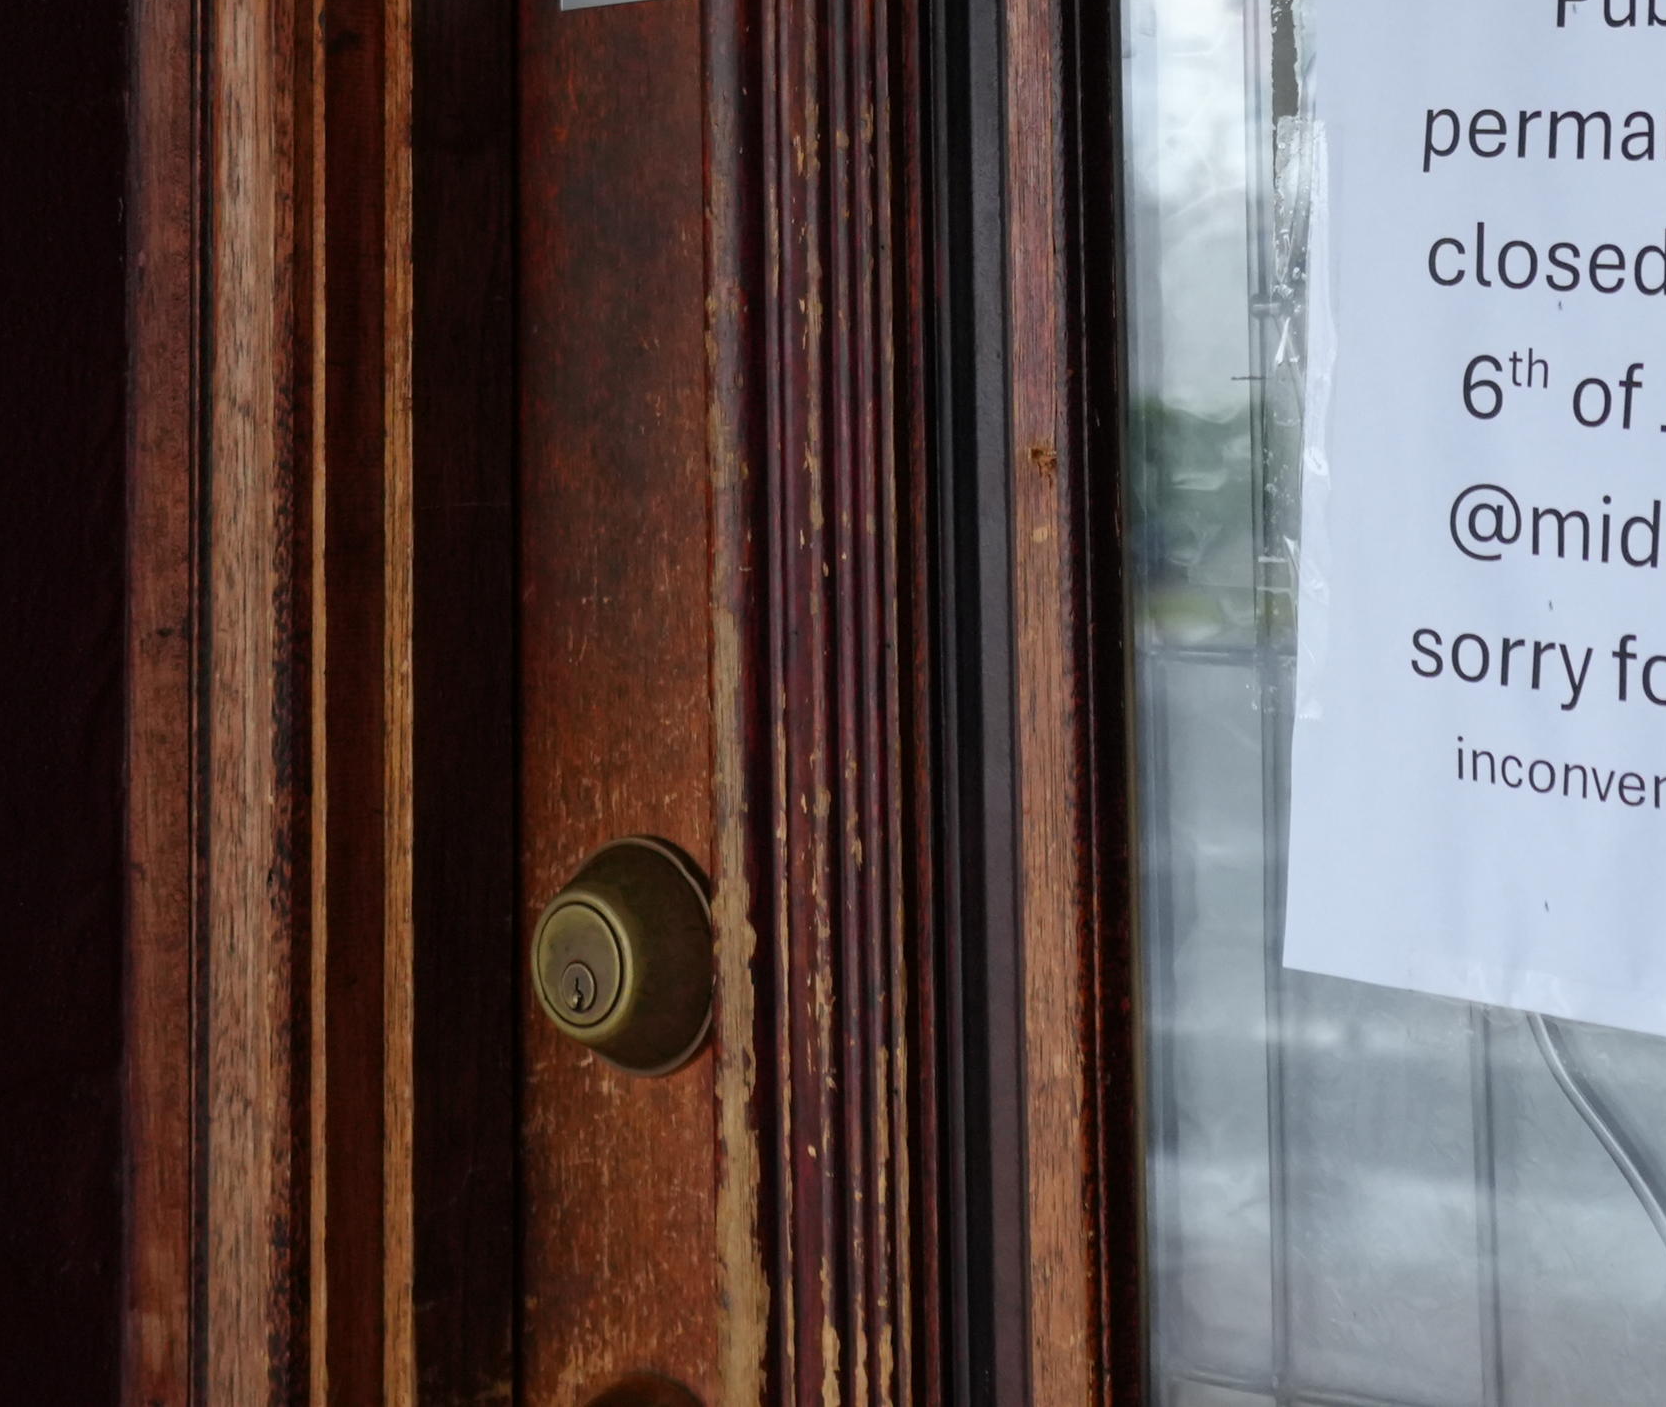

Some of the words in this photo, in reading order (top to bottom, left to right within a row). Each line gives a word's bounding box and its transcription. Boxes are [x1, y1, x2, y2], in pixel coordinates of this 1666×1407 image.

[1461, 348, 1550, 422] 6th
[1571, 362, 1645, 431] of
[1410, 626, 1594, 711] sorry
